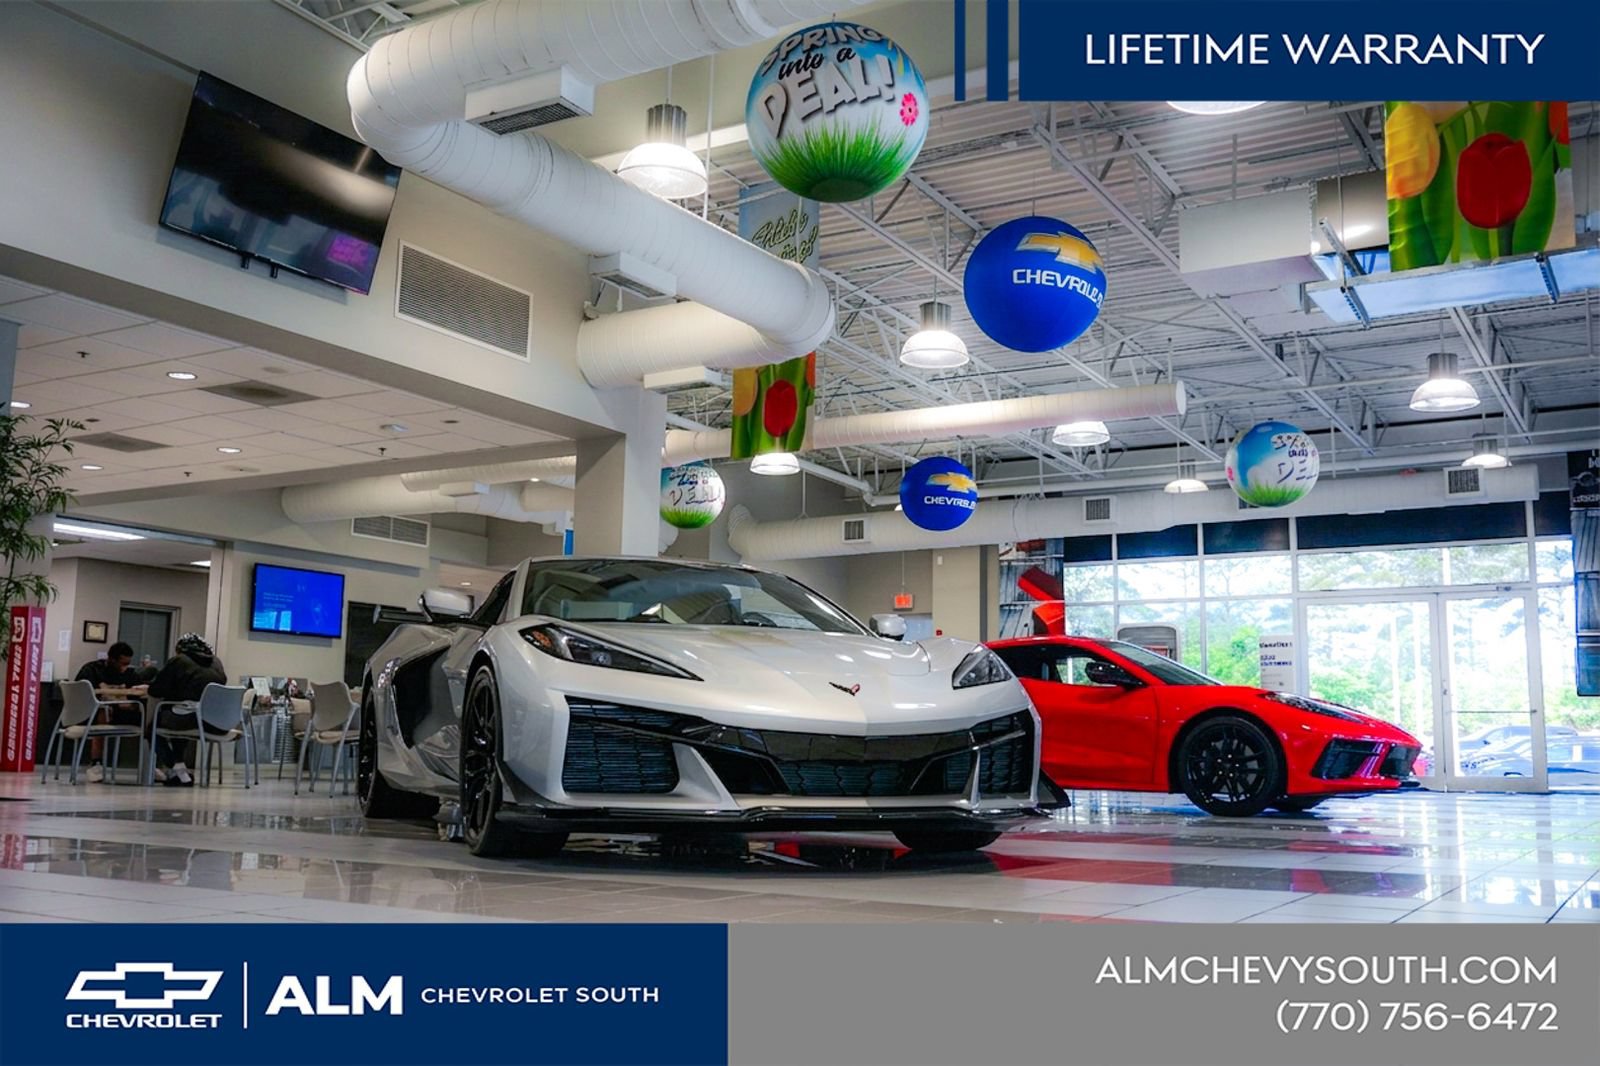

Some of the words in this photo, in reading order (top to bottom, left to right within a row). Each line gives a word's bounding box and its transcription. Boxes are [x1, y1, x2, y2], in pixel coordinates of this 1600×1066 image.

[761, 25, 885, 77] SPRING
[778, 51, 825, 80] into
[836, 47, 856, 63] a
[757, 54, 896, 138] DEAL!
